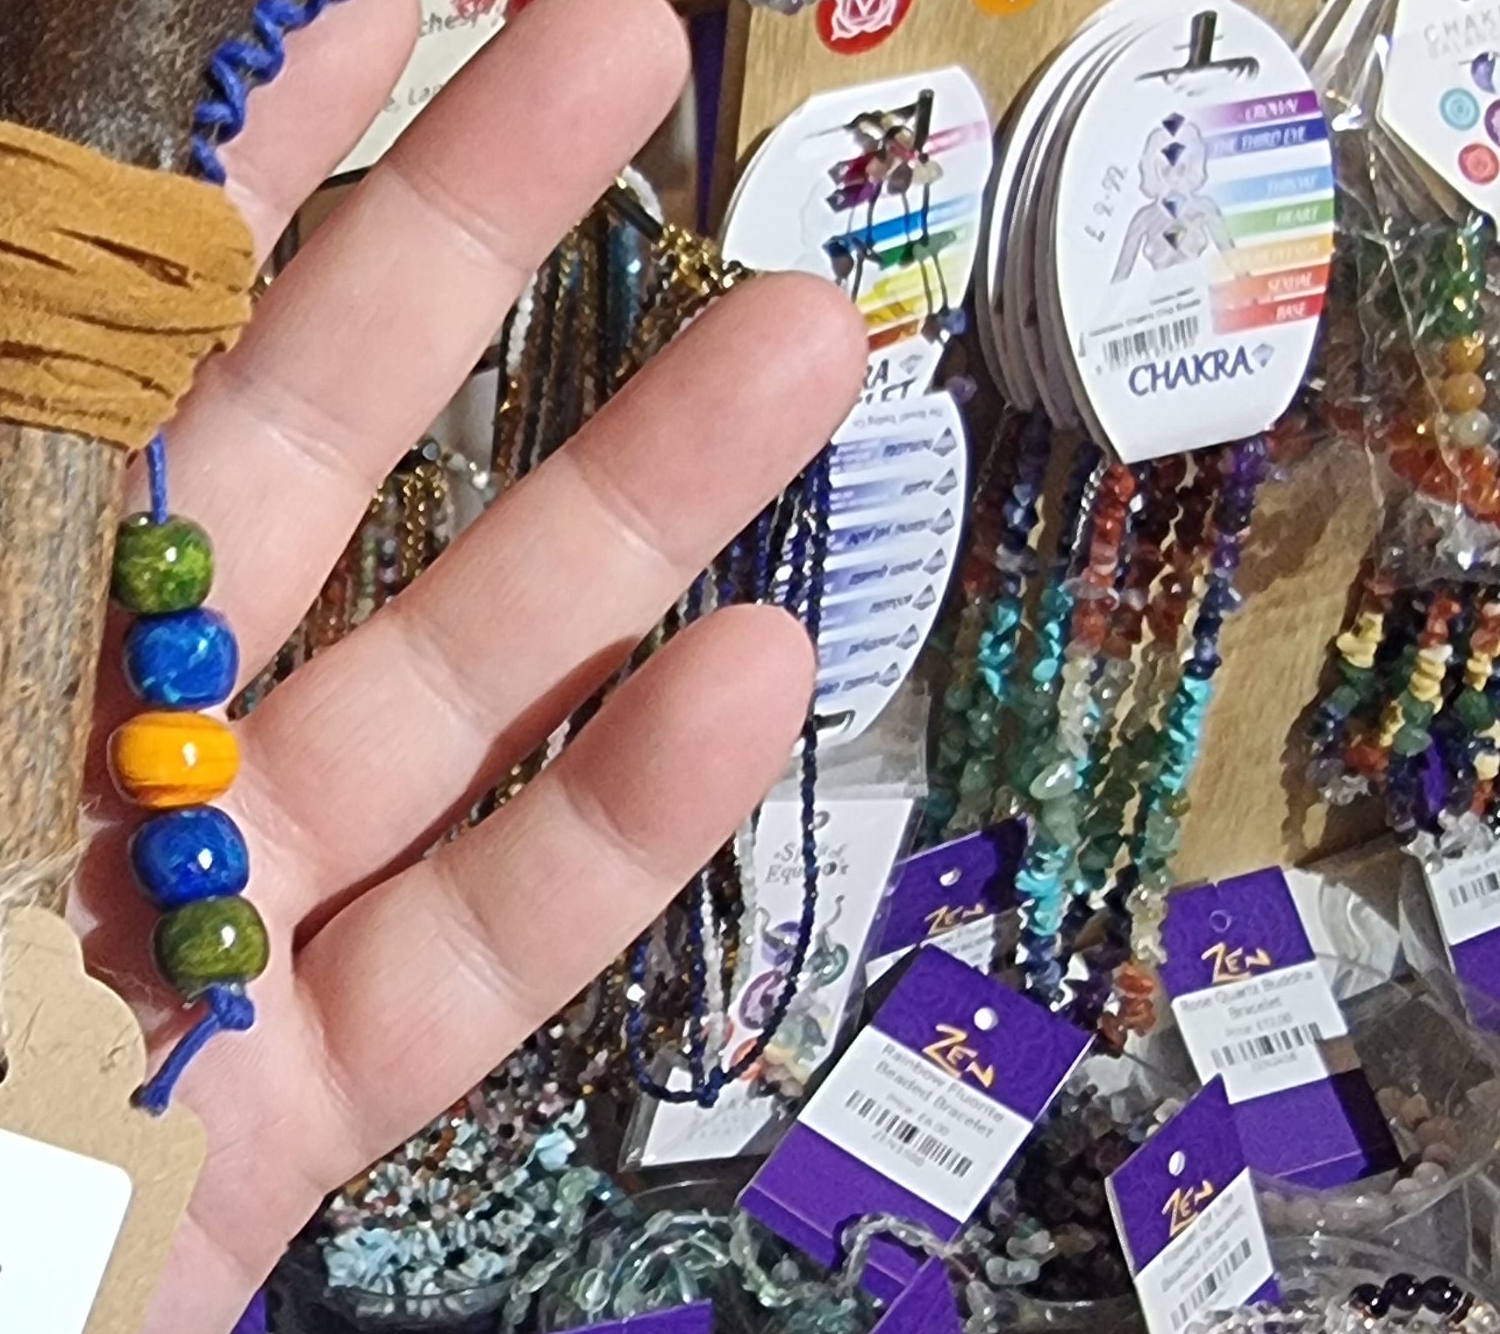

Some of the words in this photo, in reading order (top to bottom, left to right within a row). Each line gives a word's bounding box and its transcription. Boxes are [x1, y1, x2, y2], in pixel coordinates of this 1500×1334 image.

[1128, 344, 1254, 397] CHAKRA
[924, 904, 984, 936] ZEN
[1201, 942, 1271, 983] ZEN
[882, 1043, 945, 1087] Rainbow
[948, 1082, 1005, 1122] Fluorite
[922, 1024, 995, 1088] ZEN
[875, 1060, 933, 1101] Beaded
[933, 1096, 995, 1139] Bracelet
[1161, 1180, 1214, 1237] ZEN
